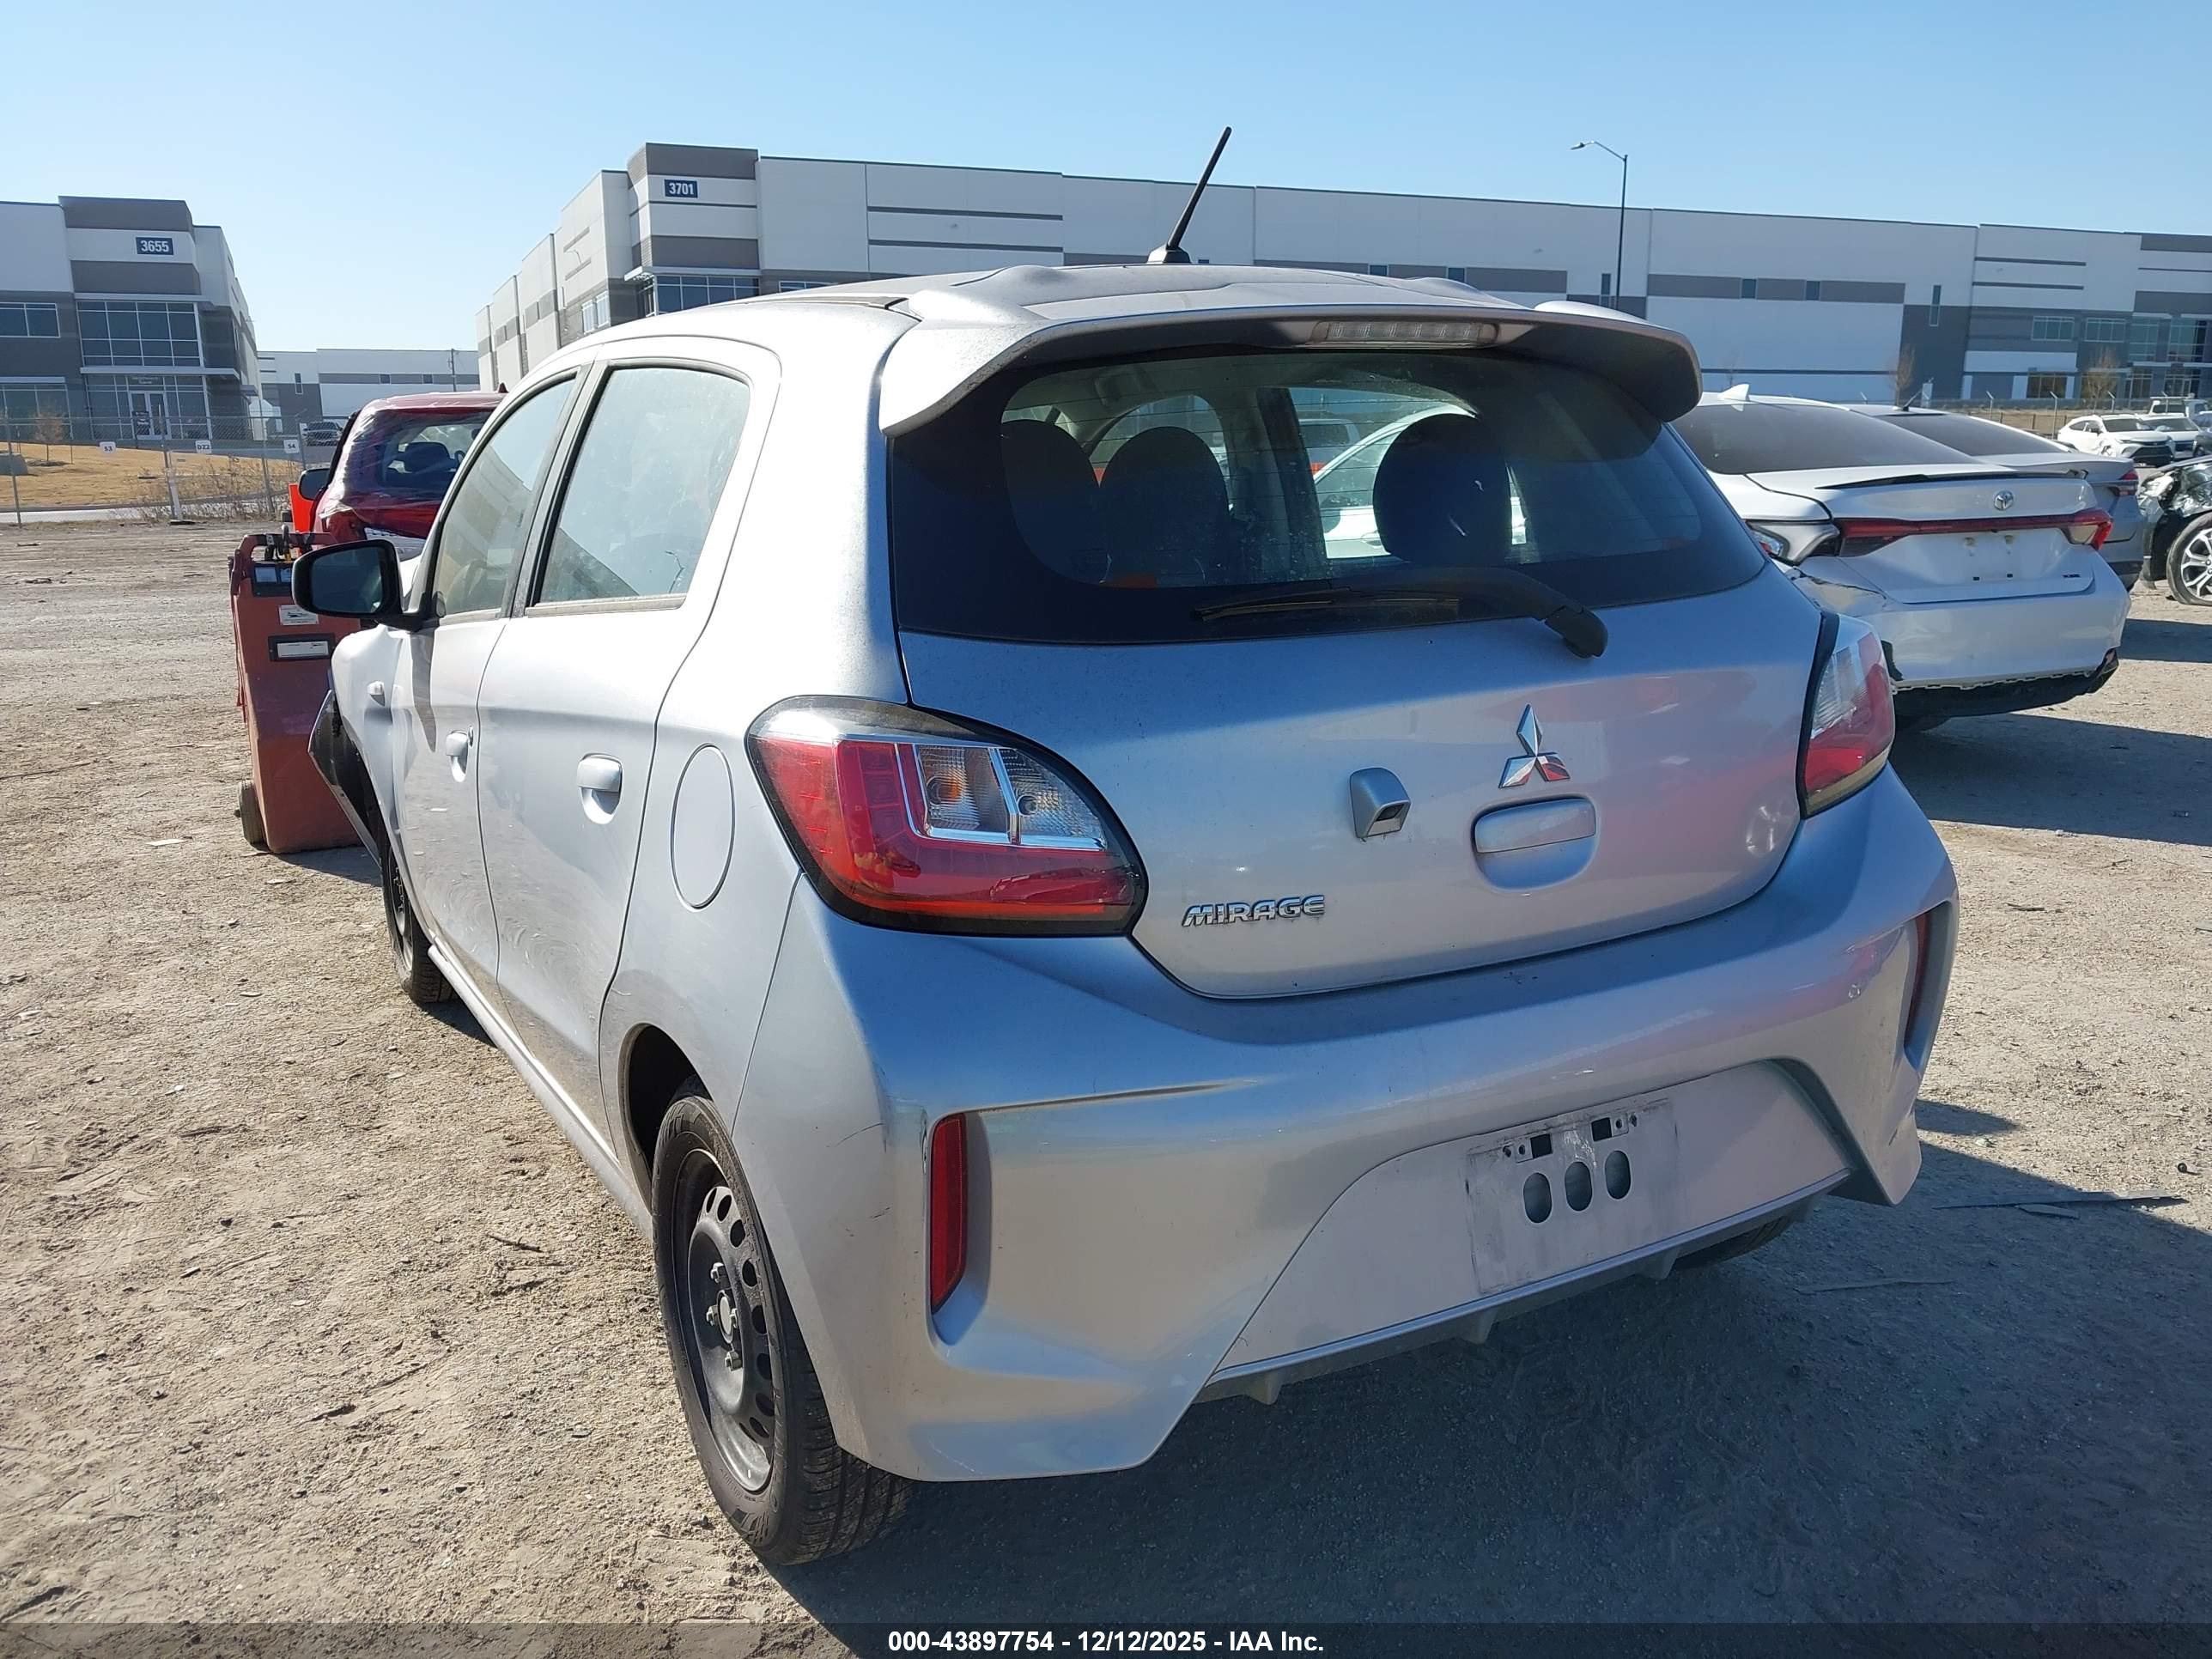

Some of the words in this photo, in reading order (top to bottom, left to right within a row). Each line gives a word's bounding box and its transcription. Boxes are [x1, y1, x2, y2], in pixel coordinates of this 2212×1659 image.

[669, 182, 694, 195] 3701
[141, 240, 169, 252] 3655
[1182, 895, 1325, 927] MIRAGE
